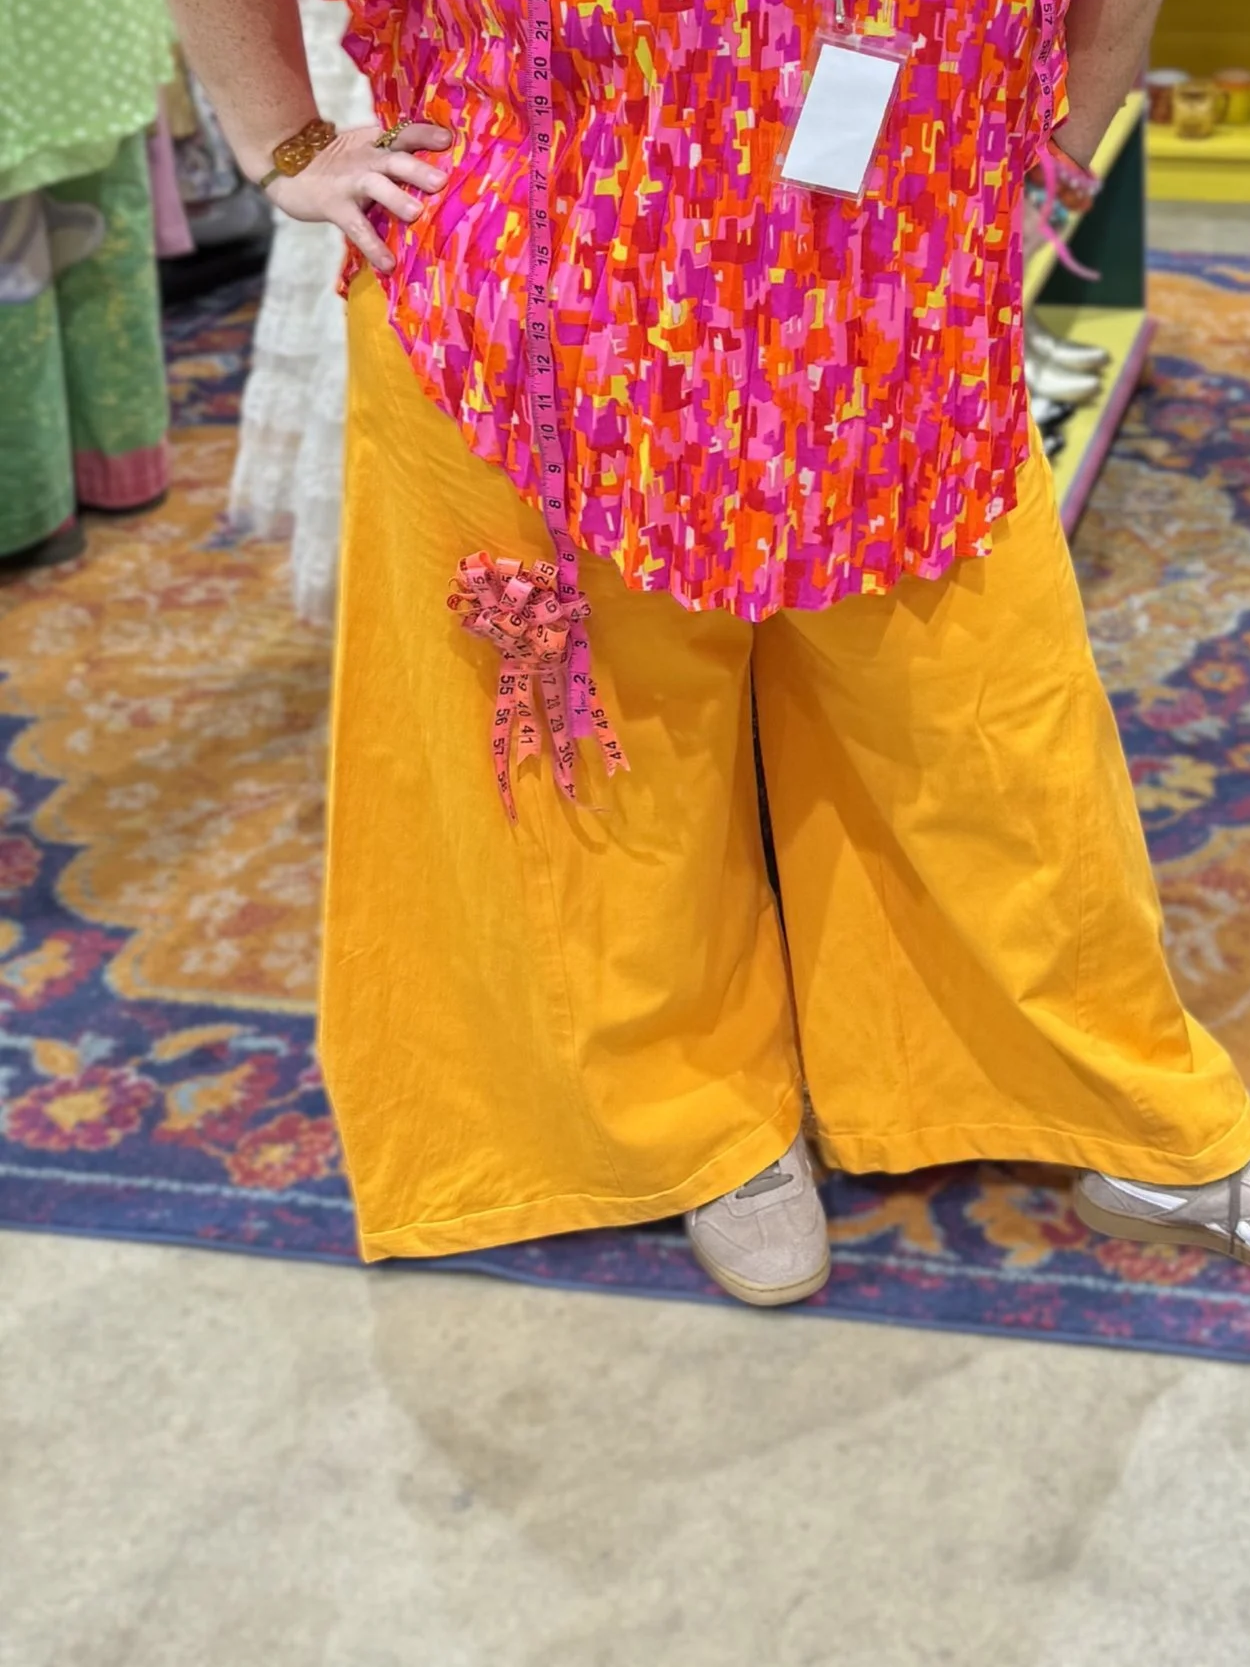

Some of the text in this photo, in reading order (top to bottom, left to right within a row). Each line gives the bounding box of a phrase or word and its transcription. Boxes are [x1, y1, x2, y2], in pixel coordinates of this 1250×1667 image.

[1043, 3, 1053, 25] 57
[535, 19, 549, 42] 21
[533, 55, 548, 81] 20
[534, 94, 549, 116] 19
[537, 132, 550, 153] 18
[535, 170, 547, 191] 17
[535, 209, 548, 230] 16
[537, 245, 549, 267] 15
[533, 283, 546, 306] 14
[532, 320, 546, 340] 13
[537, 354, 551, 375] 12
[538, 393, 551, 412] 11
[540, 423, 555, 442] 10
[548, 463, 562, 474] 9
[548, 498, 562, 510] 8
[562, 552, 575, 563] 6
[535, 563, 555, 586] 25
[562, 585, 576, 595] 5
[575, 639, 588, 649] 3
[499, 675, 515, 695] 55
[573, 674, 587, 685] 2
[494, 708, 510, 726] 56
[516, 700, 532, 717] 40
[591, 709, 608, 730] 45
[520, 725, 535, 745] 41
[493, 738, 505, 755] 57
[604, 741, 622, 761] 44
